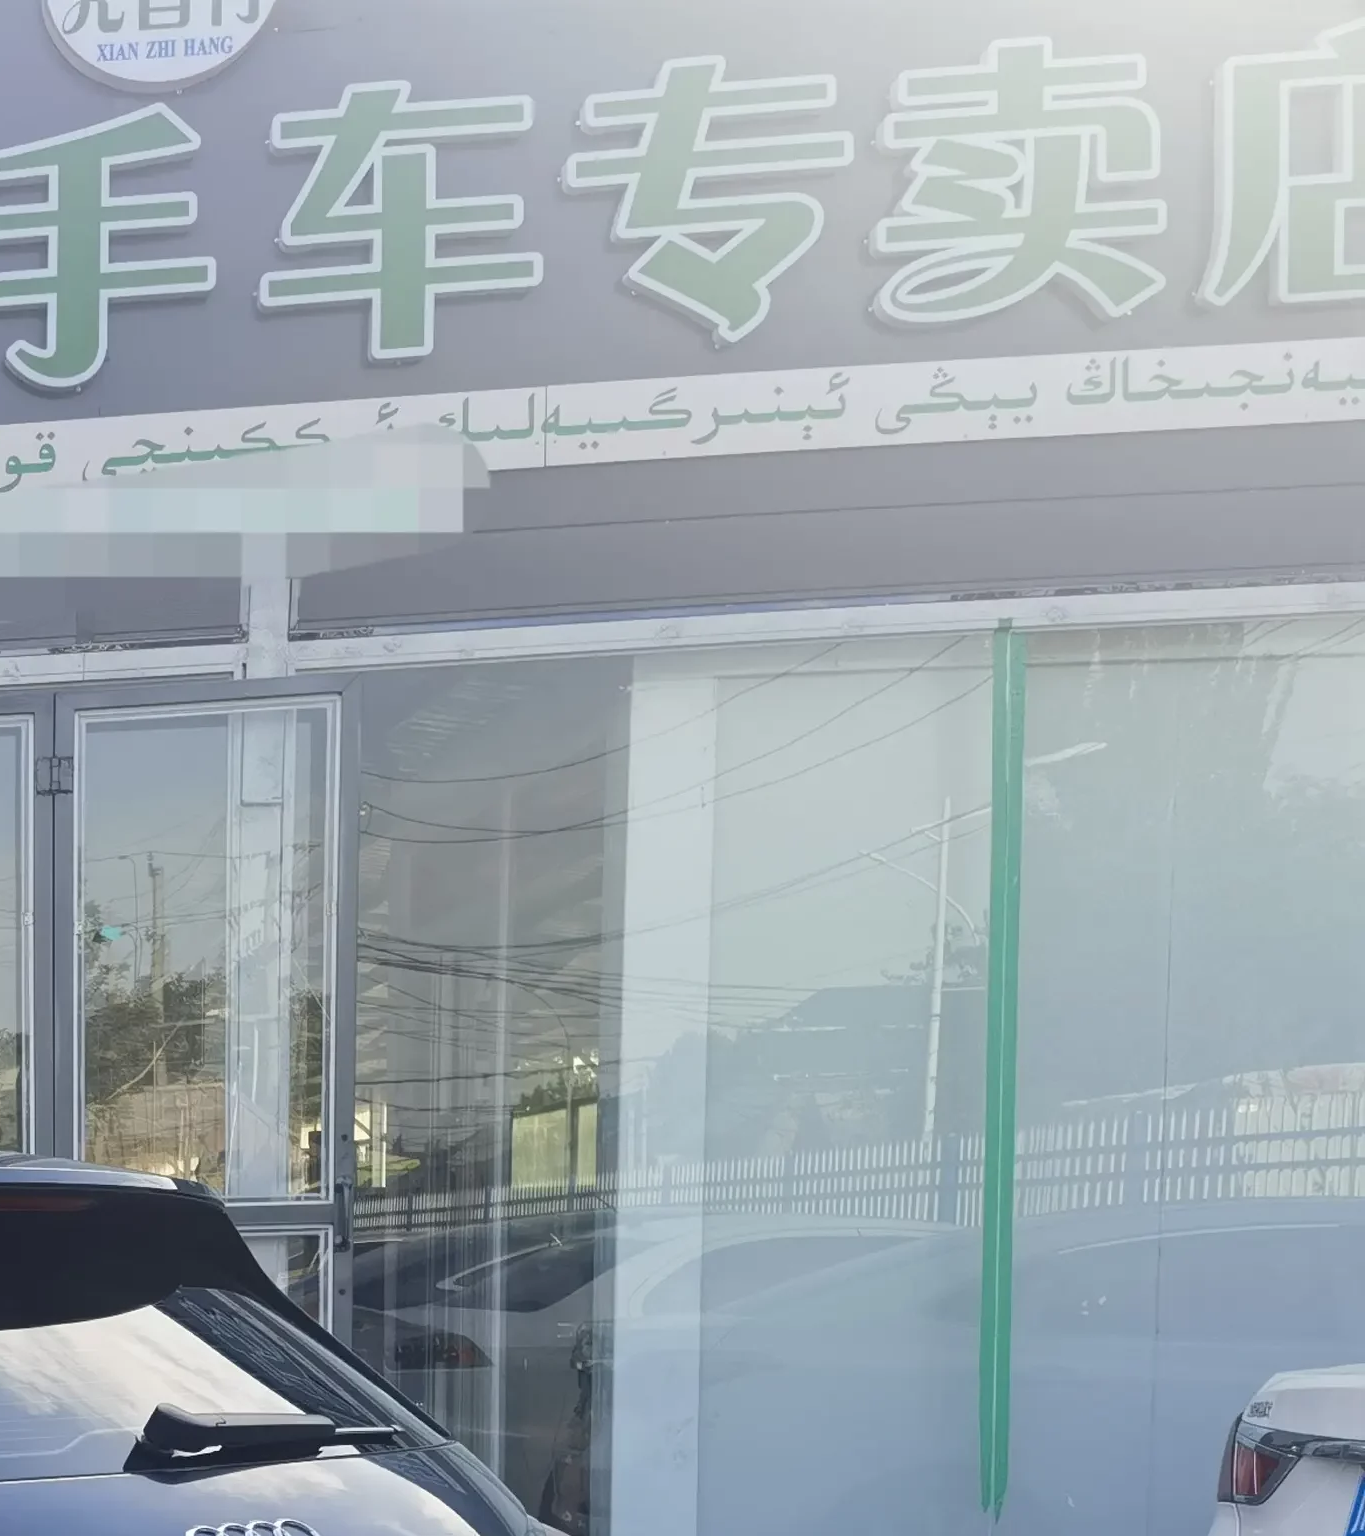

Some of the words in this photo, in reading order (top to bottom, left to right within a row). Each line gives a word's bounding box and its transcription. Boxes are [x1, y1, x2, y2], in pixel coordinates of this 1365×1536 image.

[97, 41, 139, 62] XIAN
[145, 39, 177, 60] ZHI
[183, 36, 234, 57] HANG
